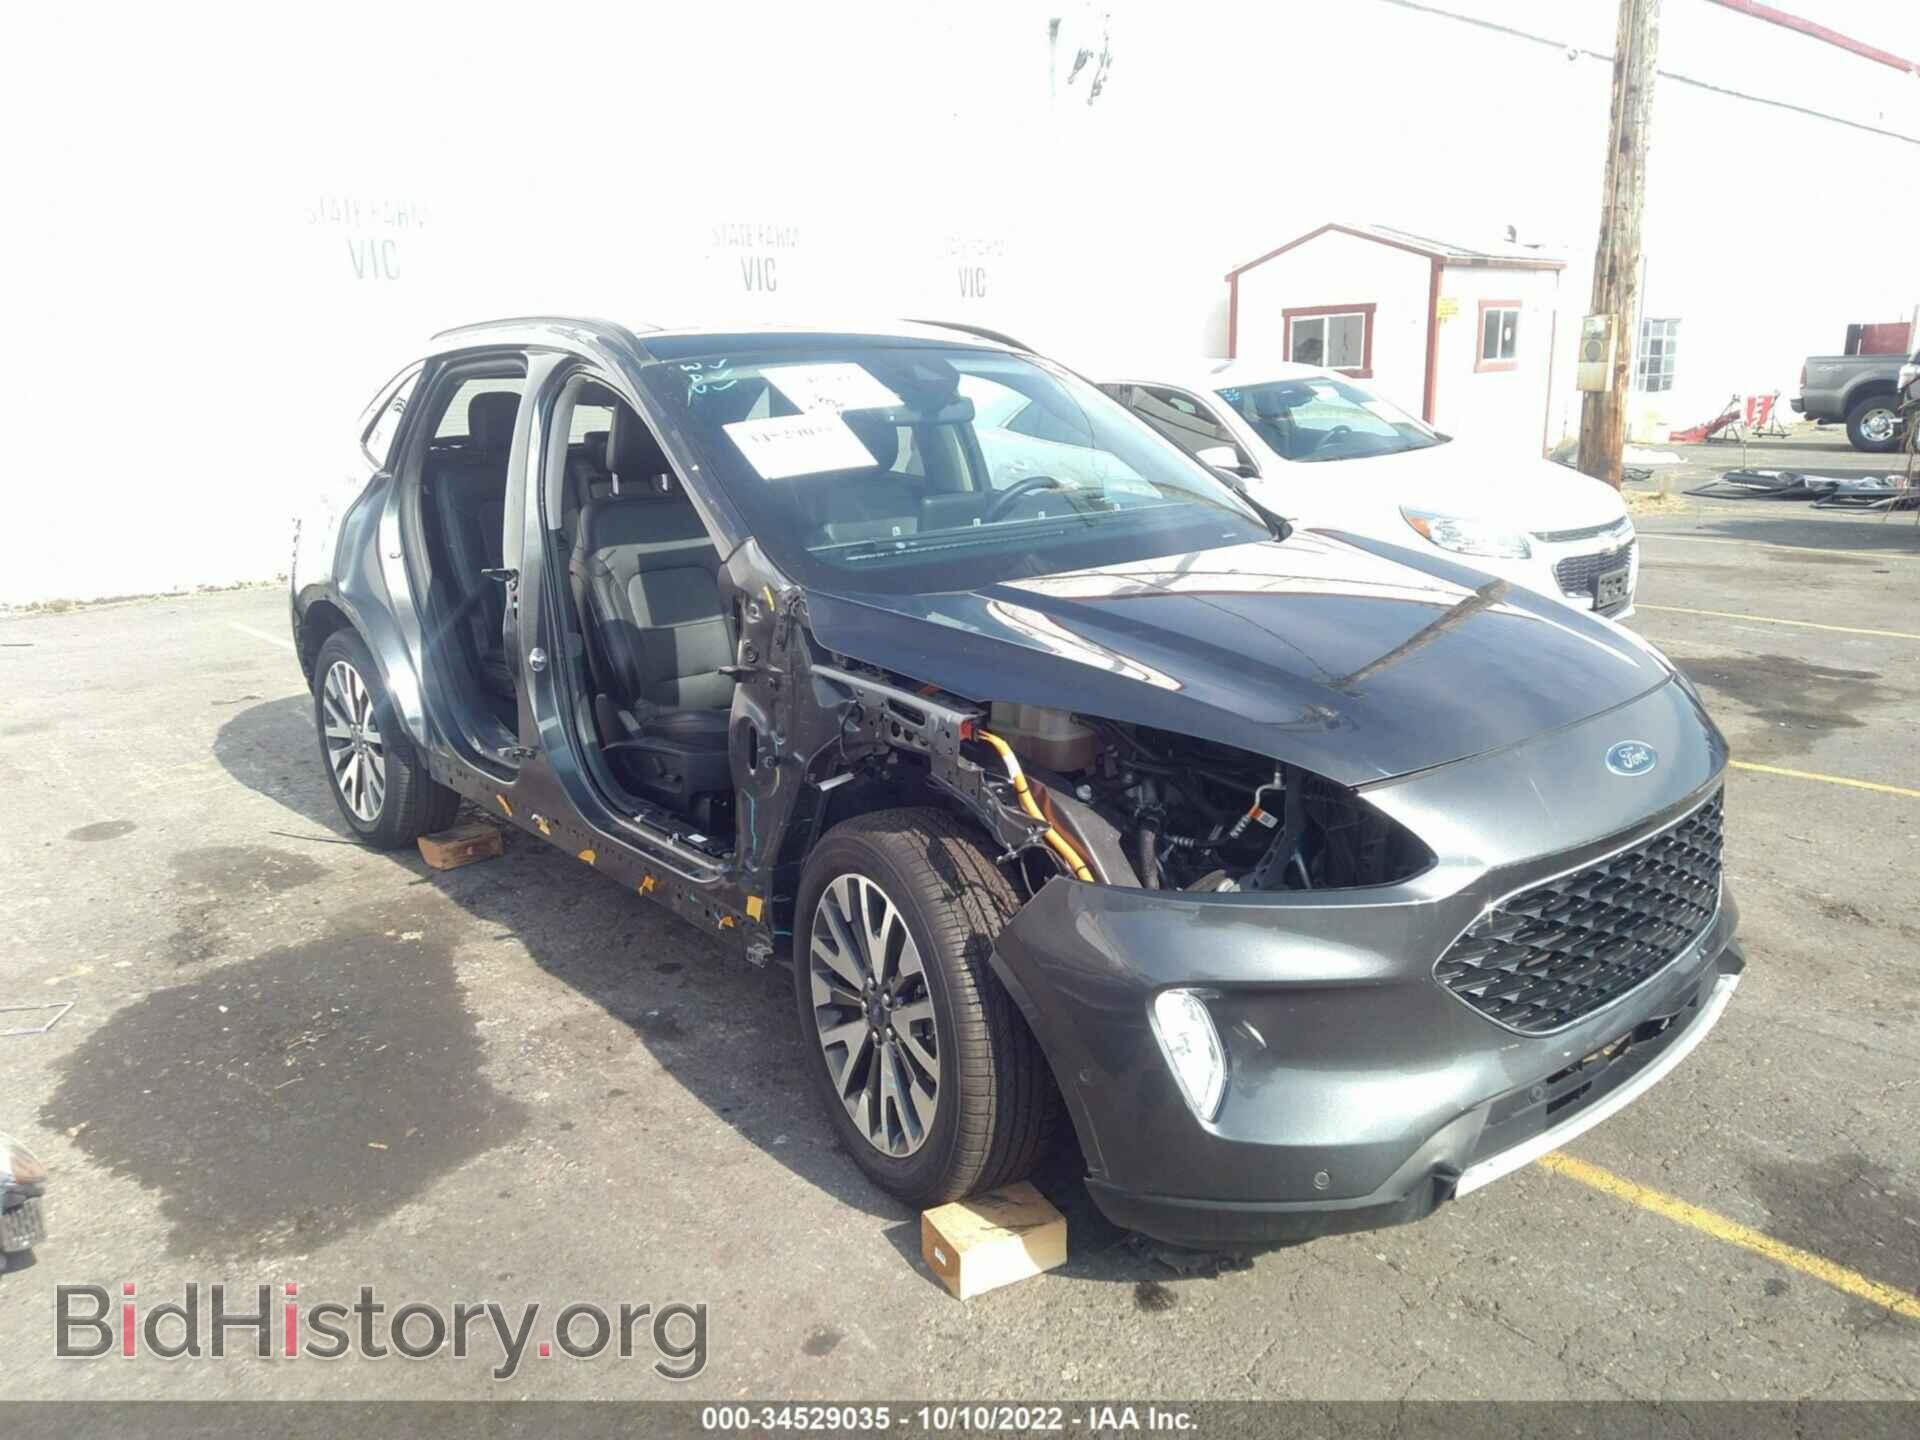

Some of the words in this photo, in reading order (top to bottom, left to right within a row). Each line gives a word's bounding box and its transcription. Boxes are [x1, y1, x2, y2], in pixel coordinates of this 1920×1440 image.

[346, 236, 401, 281] VIC
[740, 256, 777, 293] VIC
[957, 265, 987, 299] VIC
